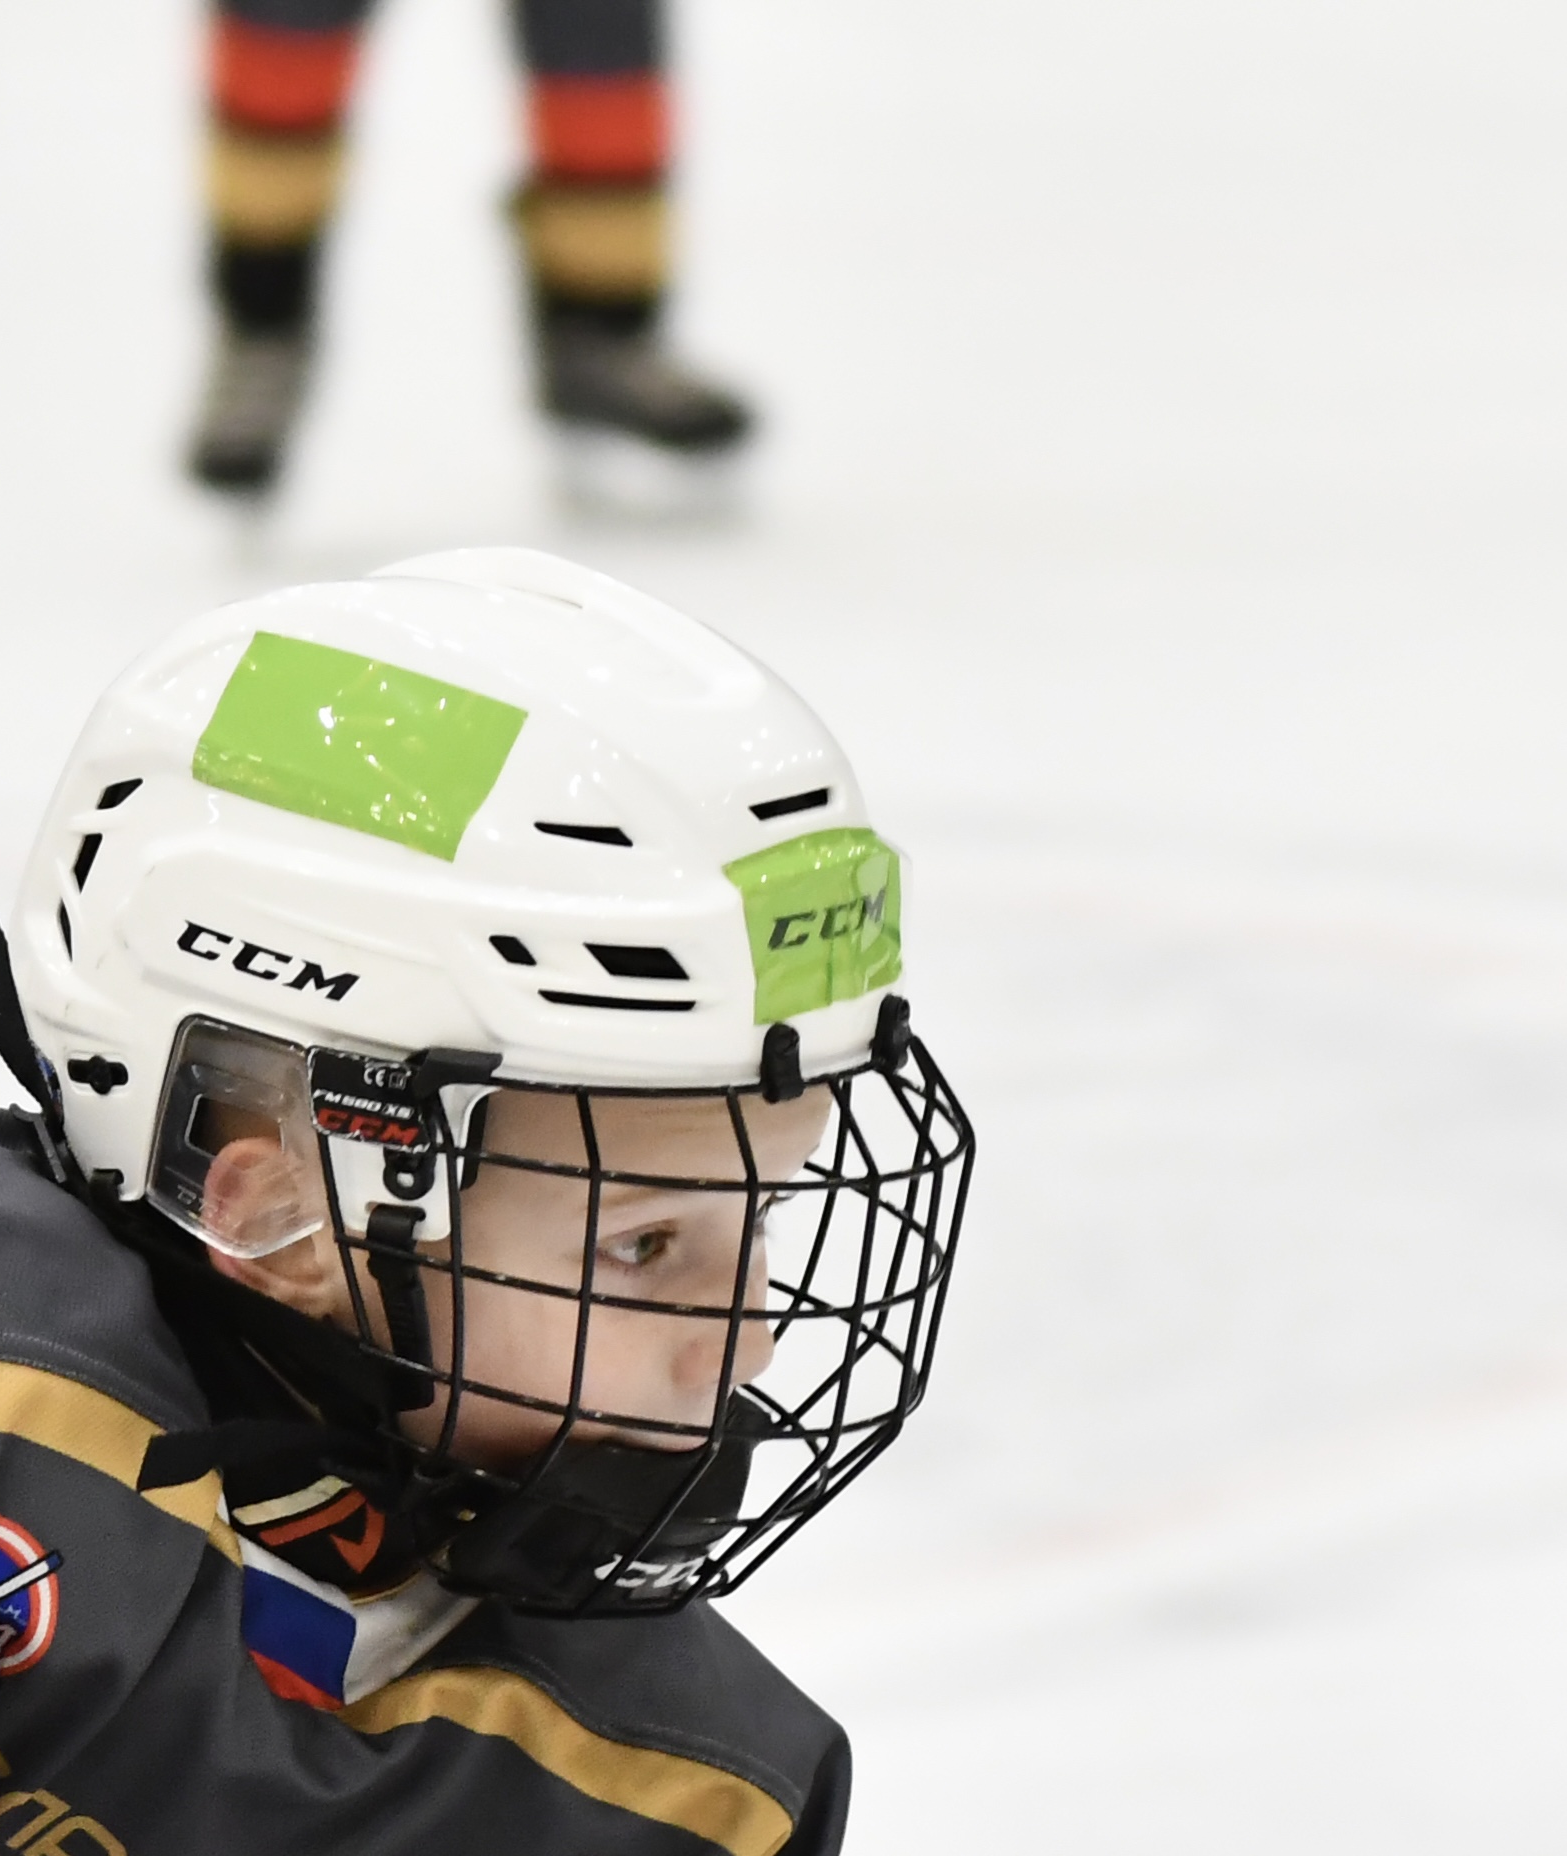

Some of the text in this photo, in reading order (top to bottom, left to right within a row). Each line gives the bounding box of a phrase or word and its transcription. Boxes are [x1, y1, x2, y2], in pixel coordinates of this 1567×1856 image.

[768, 888, 886, 950] CCM
[177, 919, 361, 1002] CCM
[317, 1108, 419, 1145] CCM
